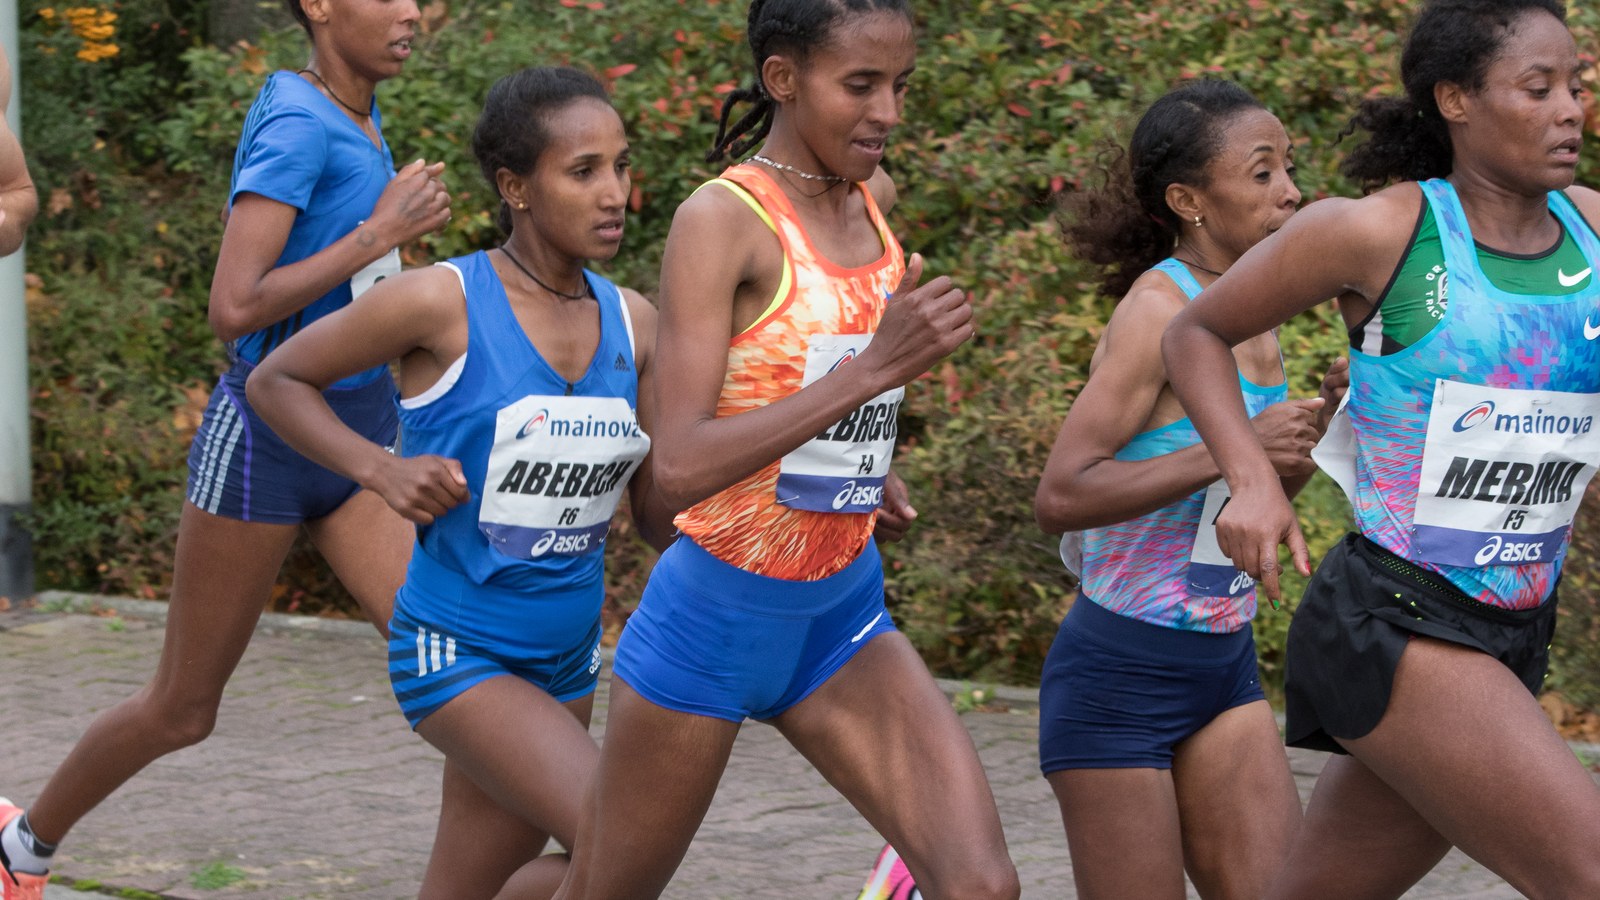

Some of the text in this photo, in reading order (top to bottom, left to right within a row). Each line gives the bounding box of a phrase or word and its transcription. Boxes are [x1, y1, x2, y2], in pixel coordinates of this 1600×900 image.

[550, 414, 641, 438] mainova
[1494, 408, 1593, 434] mainova
[858, 454, 874, 475] F4
[496, 459, 634, 498] ABEBECH
[1435, 456, 1587, 505] MERIMA
[850, 485, 885, 505] asic
[557, 507, 580, 526] F6
[1502, 509, 1529, 531] F5
[553, 532, 591, 553] asics
[1499, 542, 1544, 561] asics
